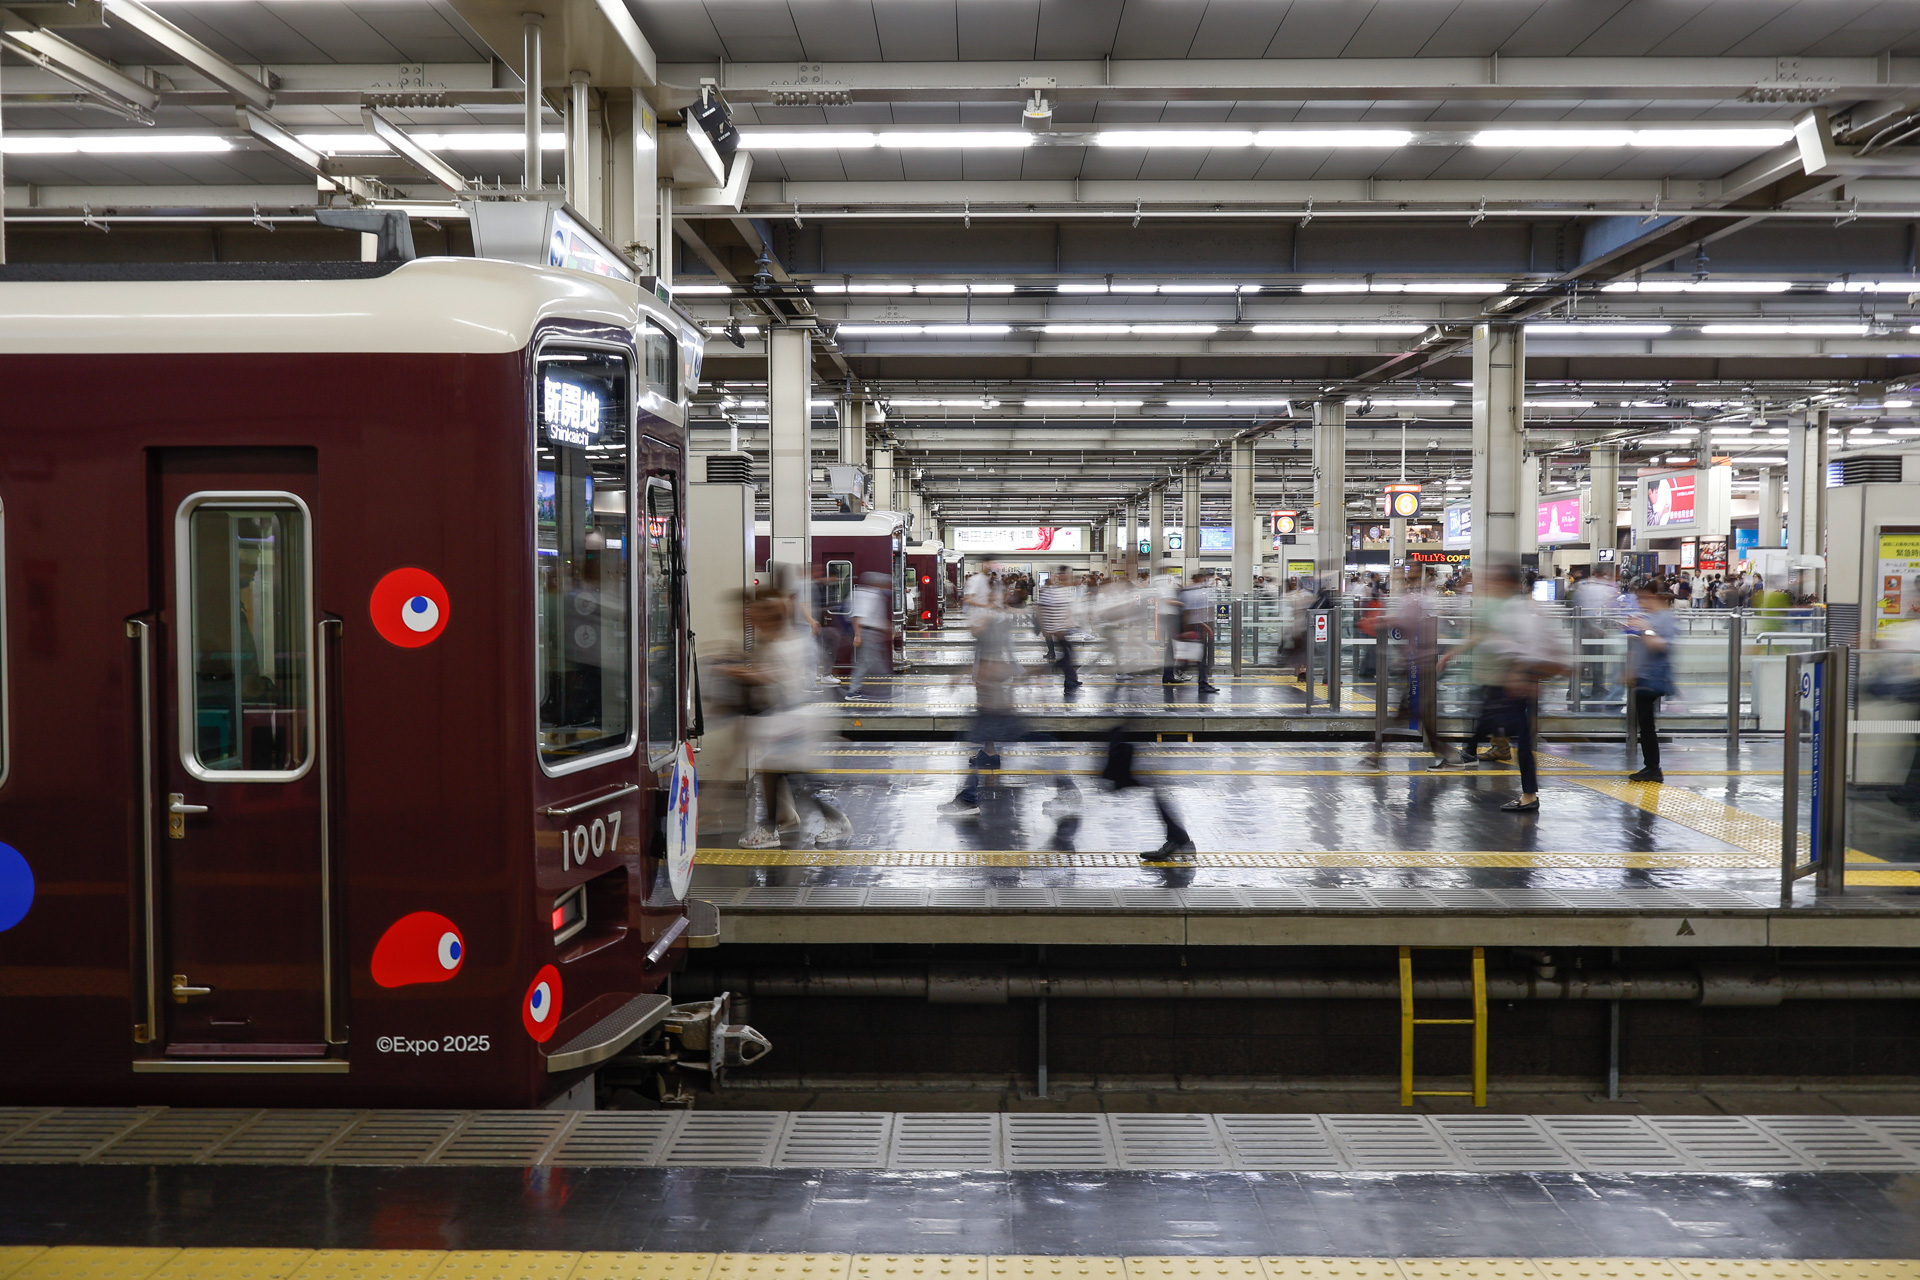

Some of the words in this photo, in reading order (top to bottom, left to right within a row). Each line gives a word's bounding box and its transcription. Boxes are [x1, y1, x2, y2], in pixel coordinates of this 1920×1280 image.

[544, 376, 600, 434] 新開地
[550, 424, 589, 446] Shinkaichi
[1400, 496, 1412, 513] 6
[1411, 552, 1445, 562] TULLY'S
[1896, 549, 1920, 557] 緊急時
[562, 810, 622, 872] 1007
[376, 1035, 439, 1056] ©Expo
[443, 1035, 490, 1052] 2025
